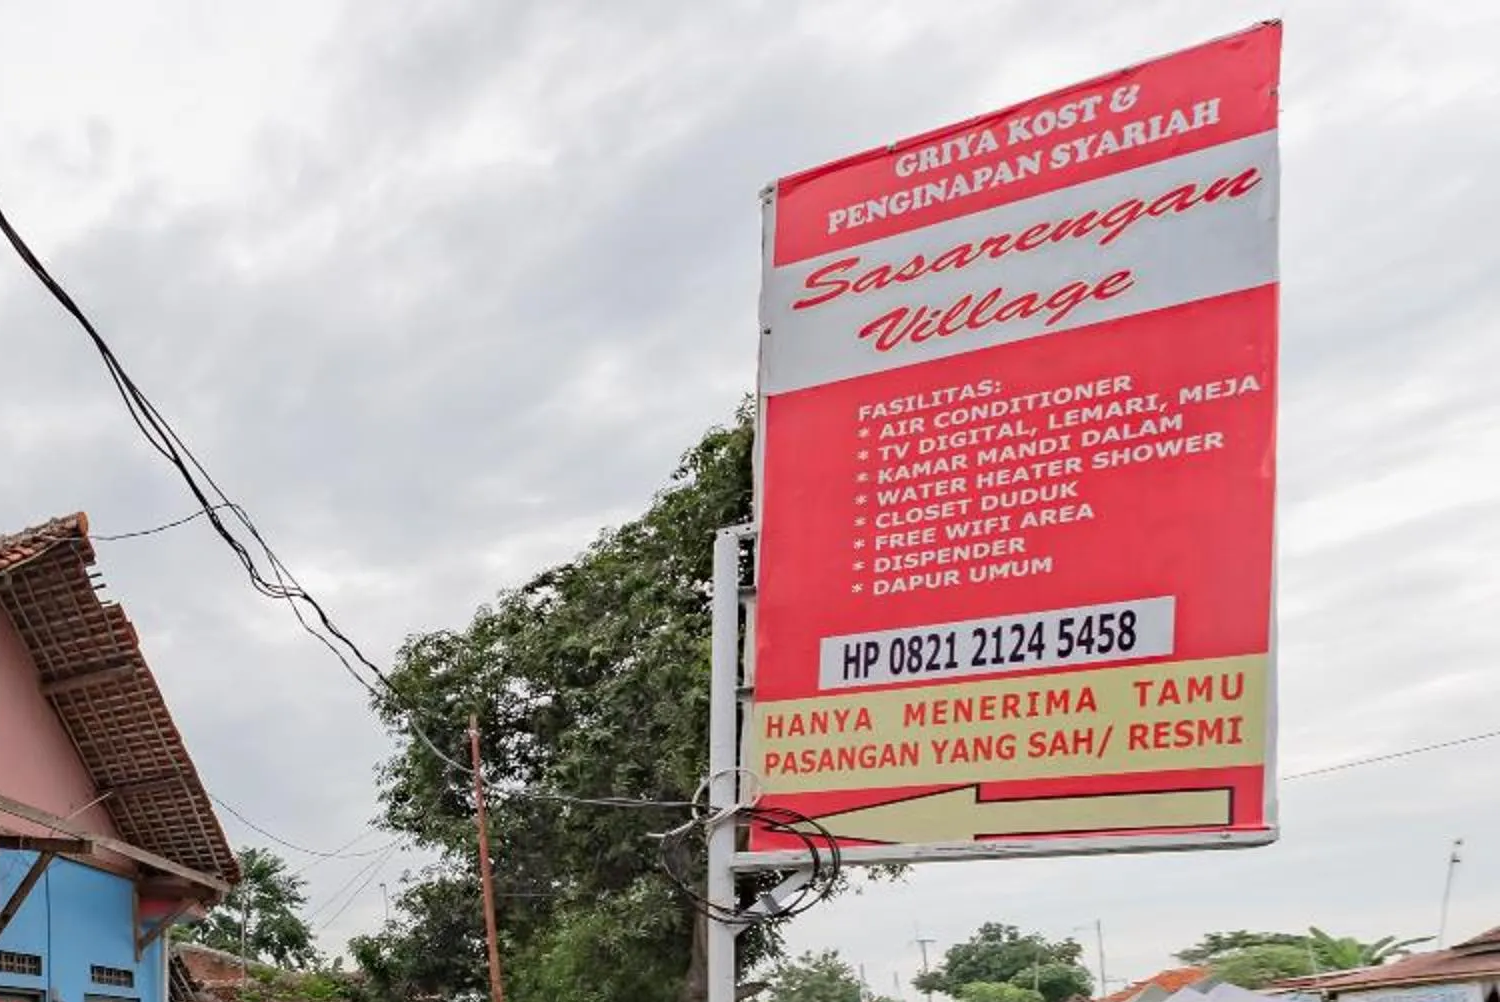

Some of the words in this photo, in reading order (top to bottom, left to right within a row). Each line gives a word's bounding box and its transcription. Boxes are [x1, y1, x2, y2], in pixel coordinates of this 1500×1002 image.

[895, 129, 997, 177] GRIYA
[1006, 94, 1102, 144] KOST
[1110, 83, 1141, 113] &
[827, 153, 1043, 235] PENGINAPAN
[1049, 97, 1221, 169] SYARIAH
[792, 167, 1263, 311] Sasarengan
[857, 266, 1135, 353] Village
[858, 379, 1002, 422] FASILITAS:
[879, 417, 925, 440] AIR
[933, 375, 1132, 429] CONDITIONER
[879, 441, 910, 462] TV
[918, 420, 1038, 456] DIGITAL,
[1048, 393, 1168, 431] LEMARI,
[1179, 374, 1261, 405] MEJA
[877, 454, 969, 485] KAMAR
[977, 434, 1071, 466] MANDI
[1081, 414, 1183, 448] DALAM
[877, 477, 967, 506] WATER
[975, 457, 1082, 489] HEATER
[1091, 431, 1224, 469] SHOWER
[874, 528, 937, 551] FREE
[945, 515, 1011, 540] WIFI
[1020, 503, 1095, 529] AREA
[875, 499, 973, 529] CLOSET
[980, 481, 1079, 512] DUDUK
[873, 537, 1026, 573] DISPENDER
[873, 569, 961, 596] DAPUR
[968, 556, 1053, 583] UMUM
[841, 641, 881, 681] HP
[888, 629, 959, 676] 0821
[970, 620, 1046, 668] 2124
[1057, 609, 1138, 659] 5458
[765, 707, 874, 739] HANYA
[902, 686, 1098, 729] MENERIMA
[1133, 672, 1246, 708] TAMU
[764, 740, 921, 777] PASANGAN
[930, 734, 1017, 766] YANG
[1027, 725, 1113, 759] SAH/
[1127, 716, 1244, 752] RESMI
